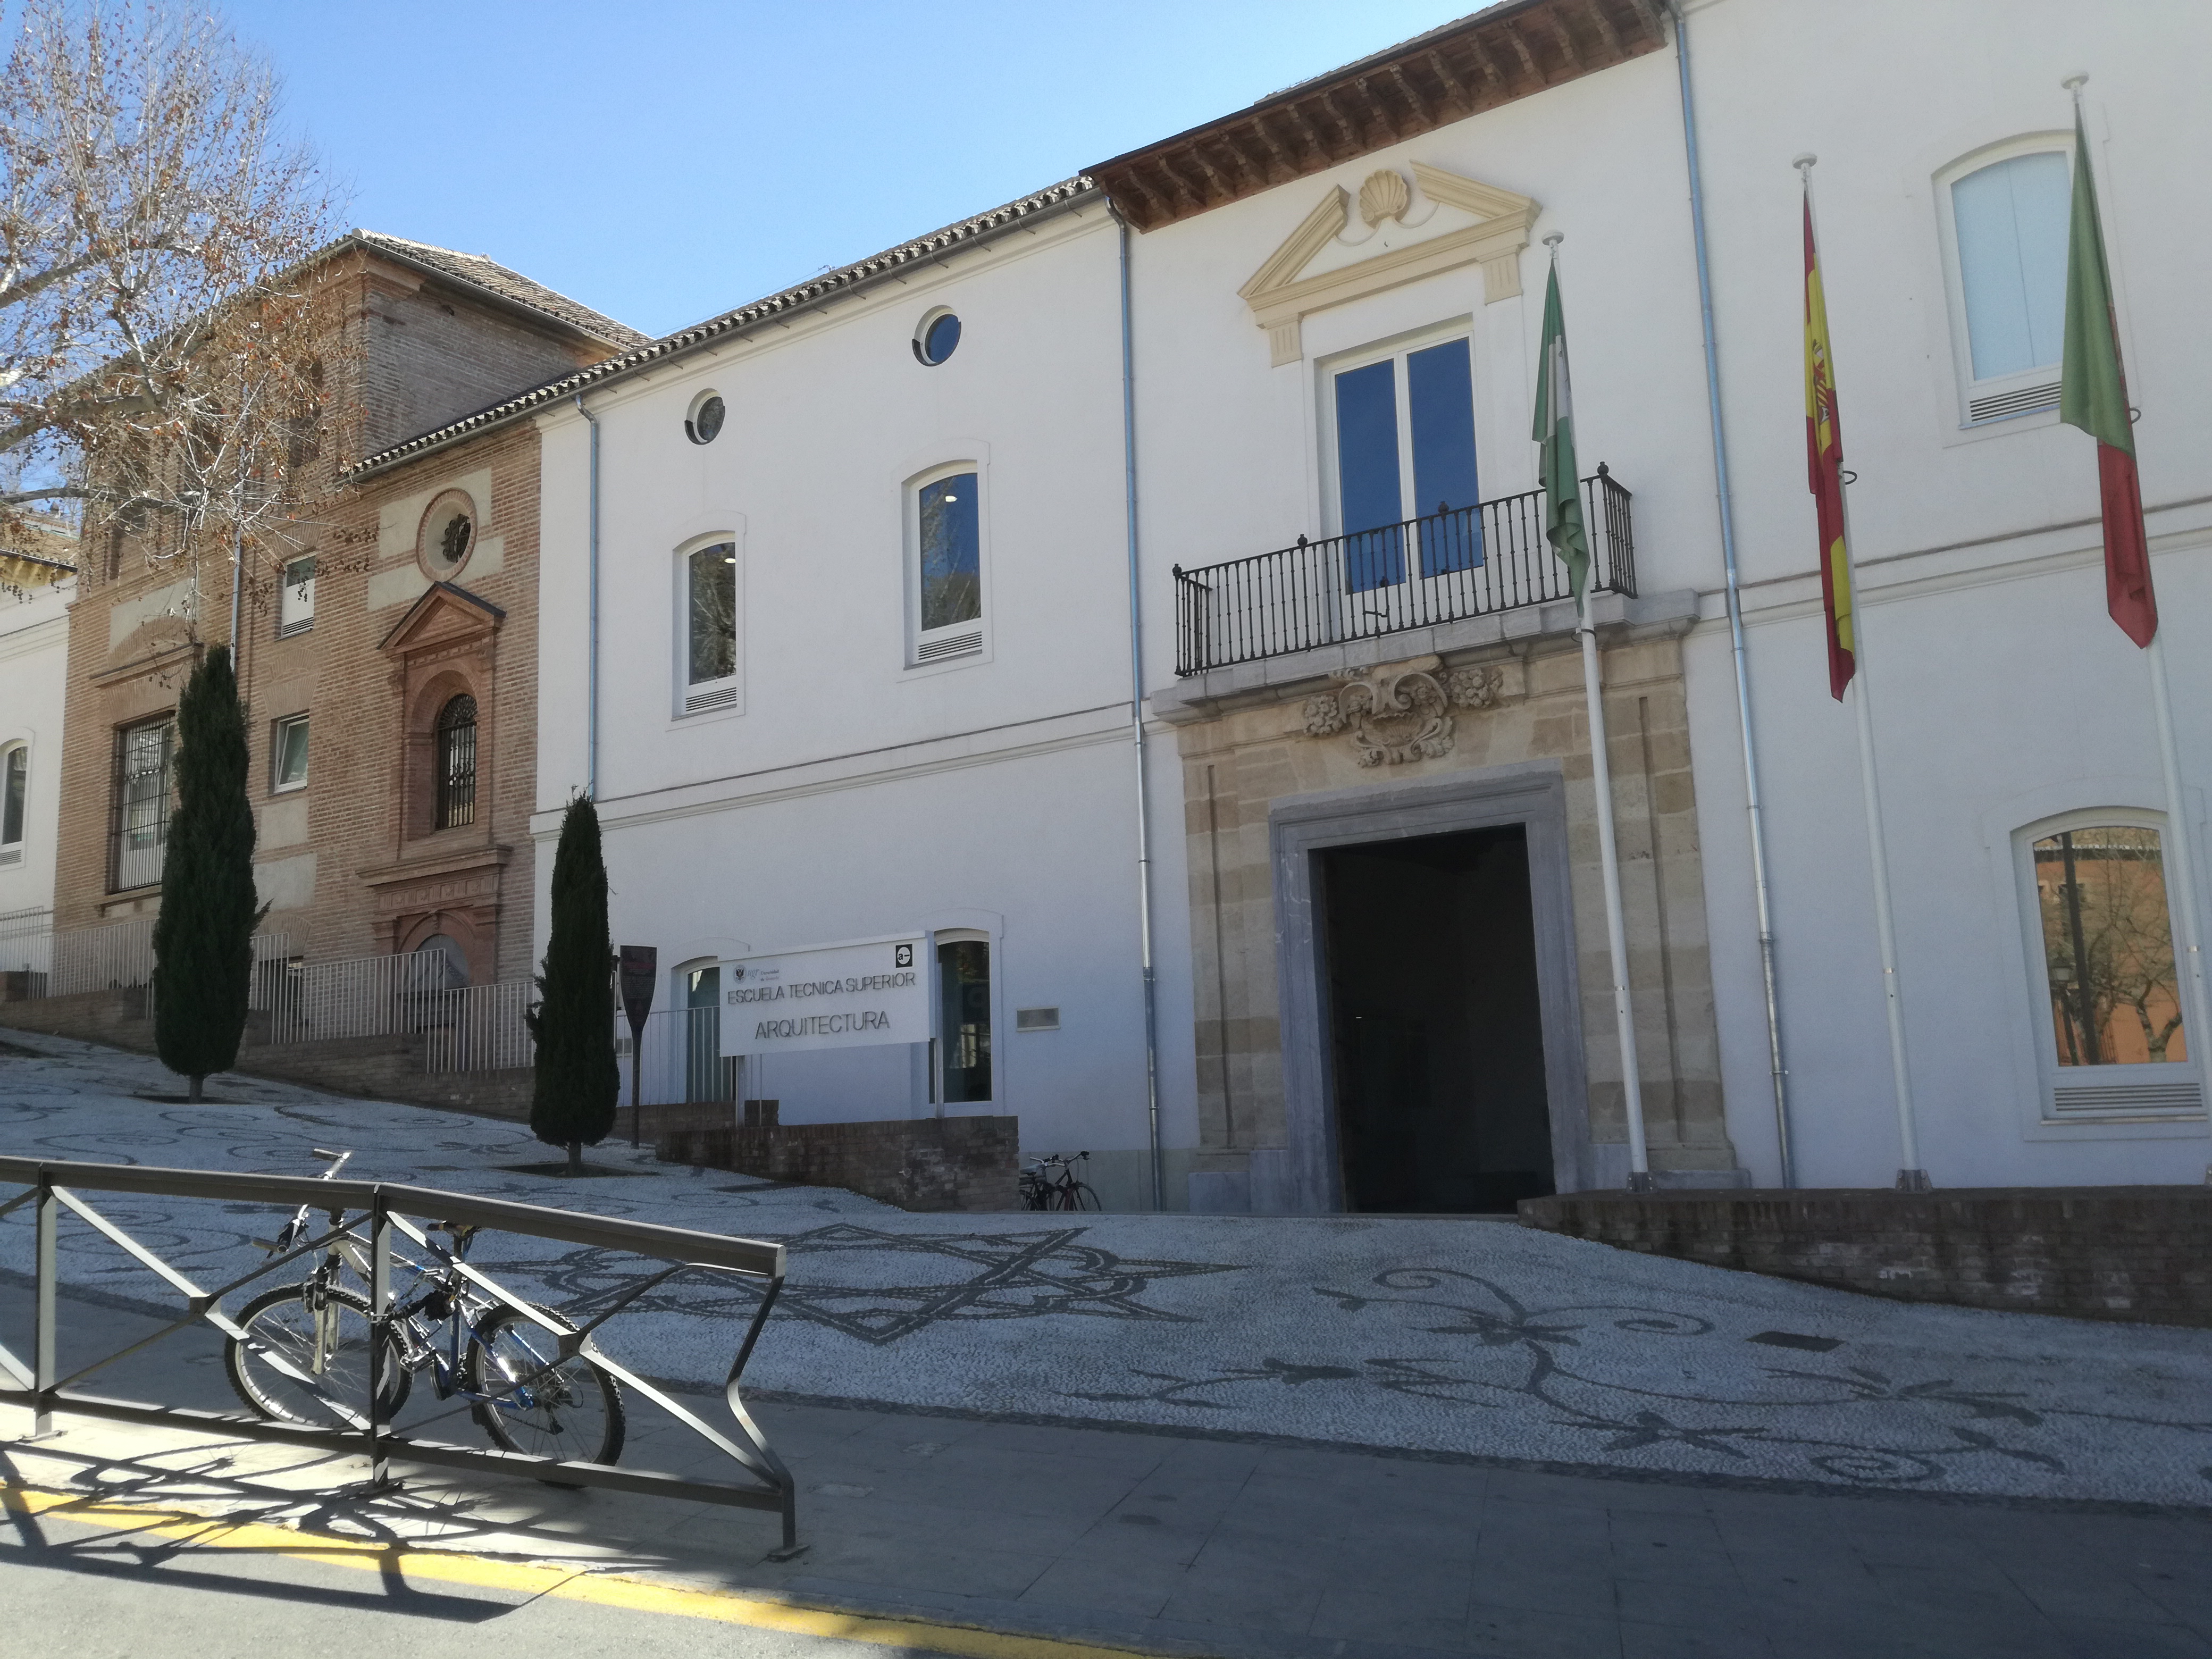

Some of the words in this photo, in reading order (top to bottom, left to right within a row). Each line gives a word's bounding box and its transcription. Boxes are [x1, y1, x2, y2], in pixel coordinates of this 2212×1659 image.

[727, 986, 785, 1004] ESCUELA
[787, 980, 844, 998] TECNICA
[845, 972, 916, 992] SUPERIOR
[755, 1011, 890, 1039] ARQUITECTURA
